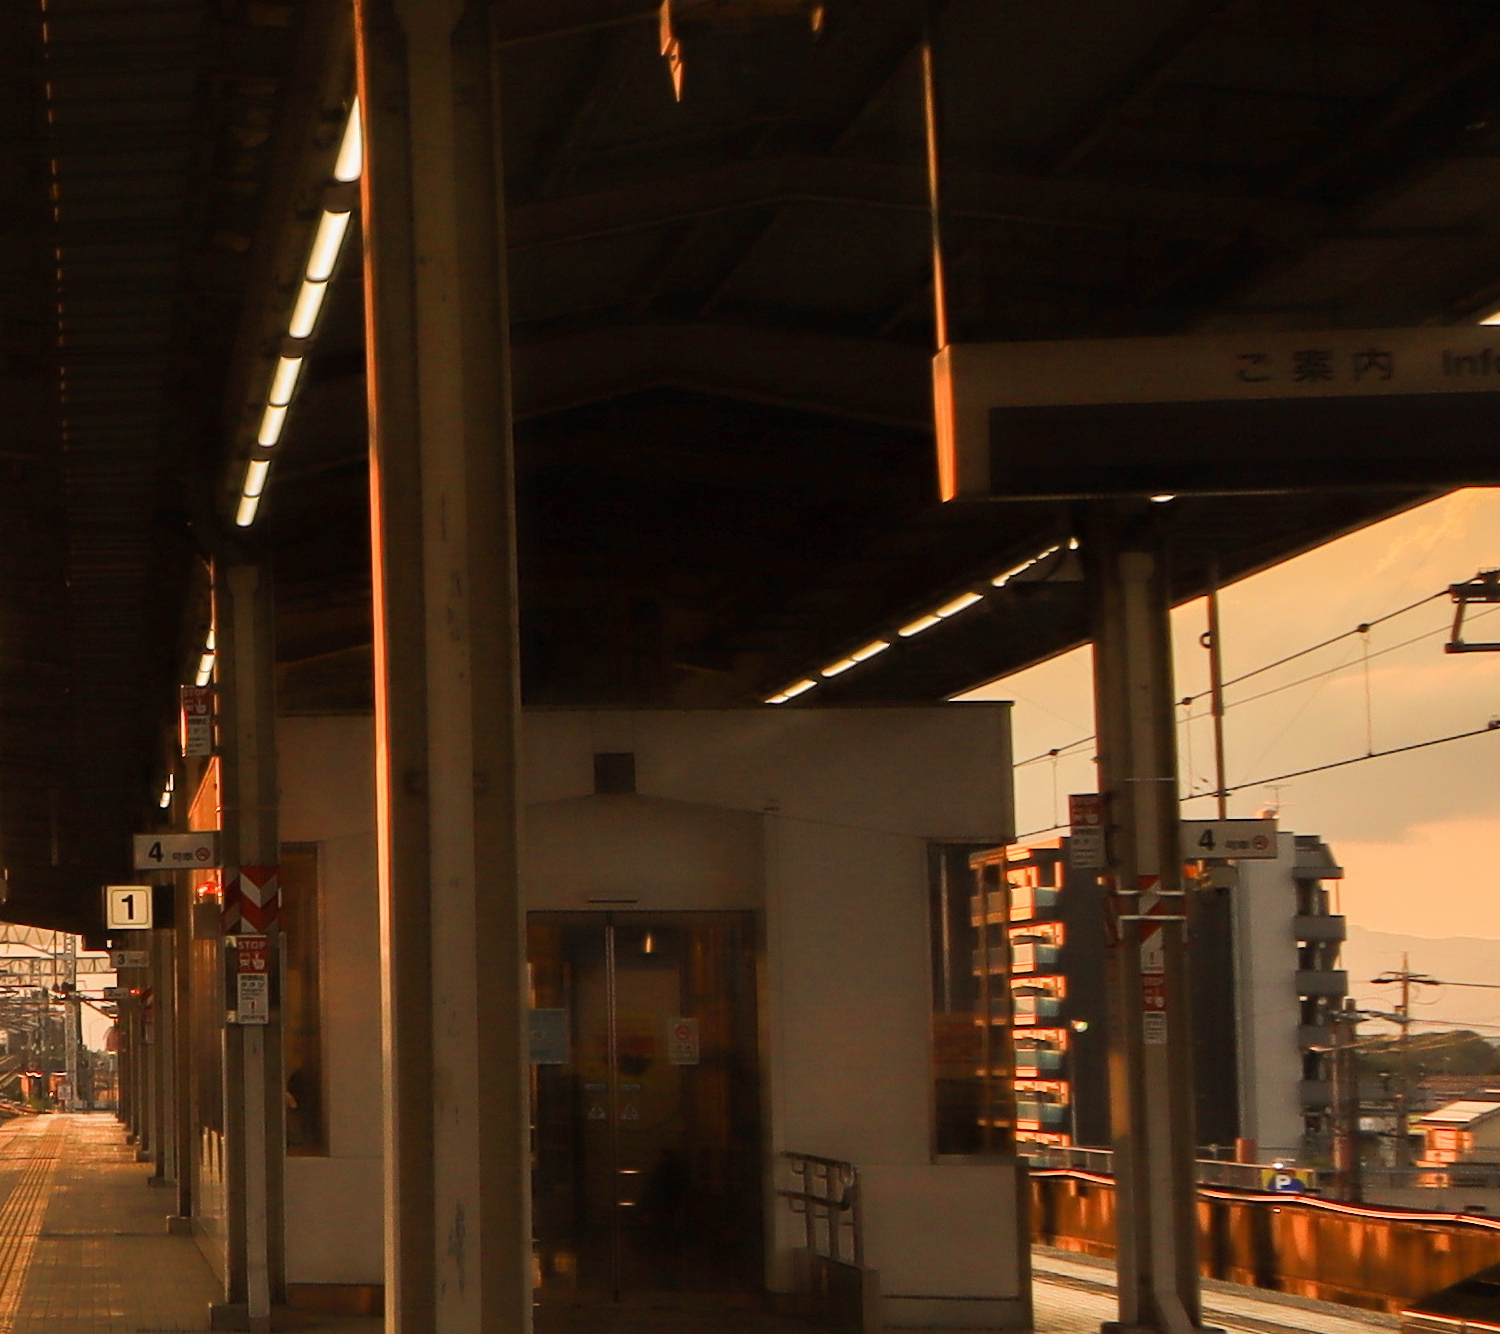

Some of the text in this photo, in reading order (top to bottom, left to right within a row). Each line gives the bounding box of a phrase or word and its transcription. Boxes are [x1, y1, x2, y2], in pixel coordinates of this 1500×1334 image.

[1236, 348, 1500, 383] ご案内 Inf
[1198, 828, 1217, 851] 4
[148, 841, 164, 863] 4
[121, 894, 135, 921] 1
[238, 940, 267, 950] STOP
[1274, 1173, 1291, 1190] P
